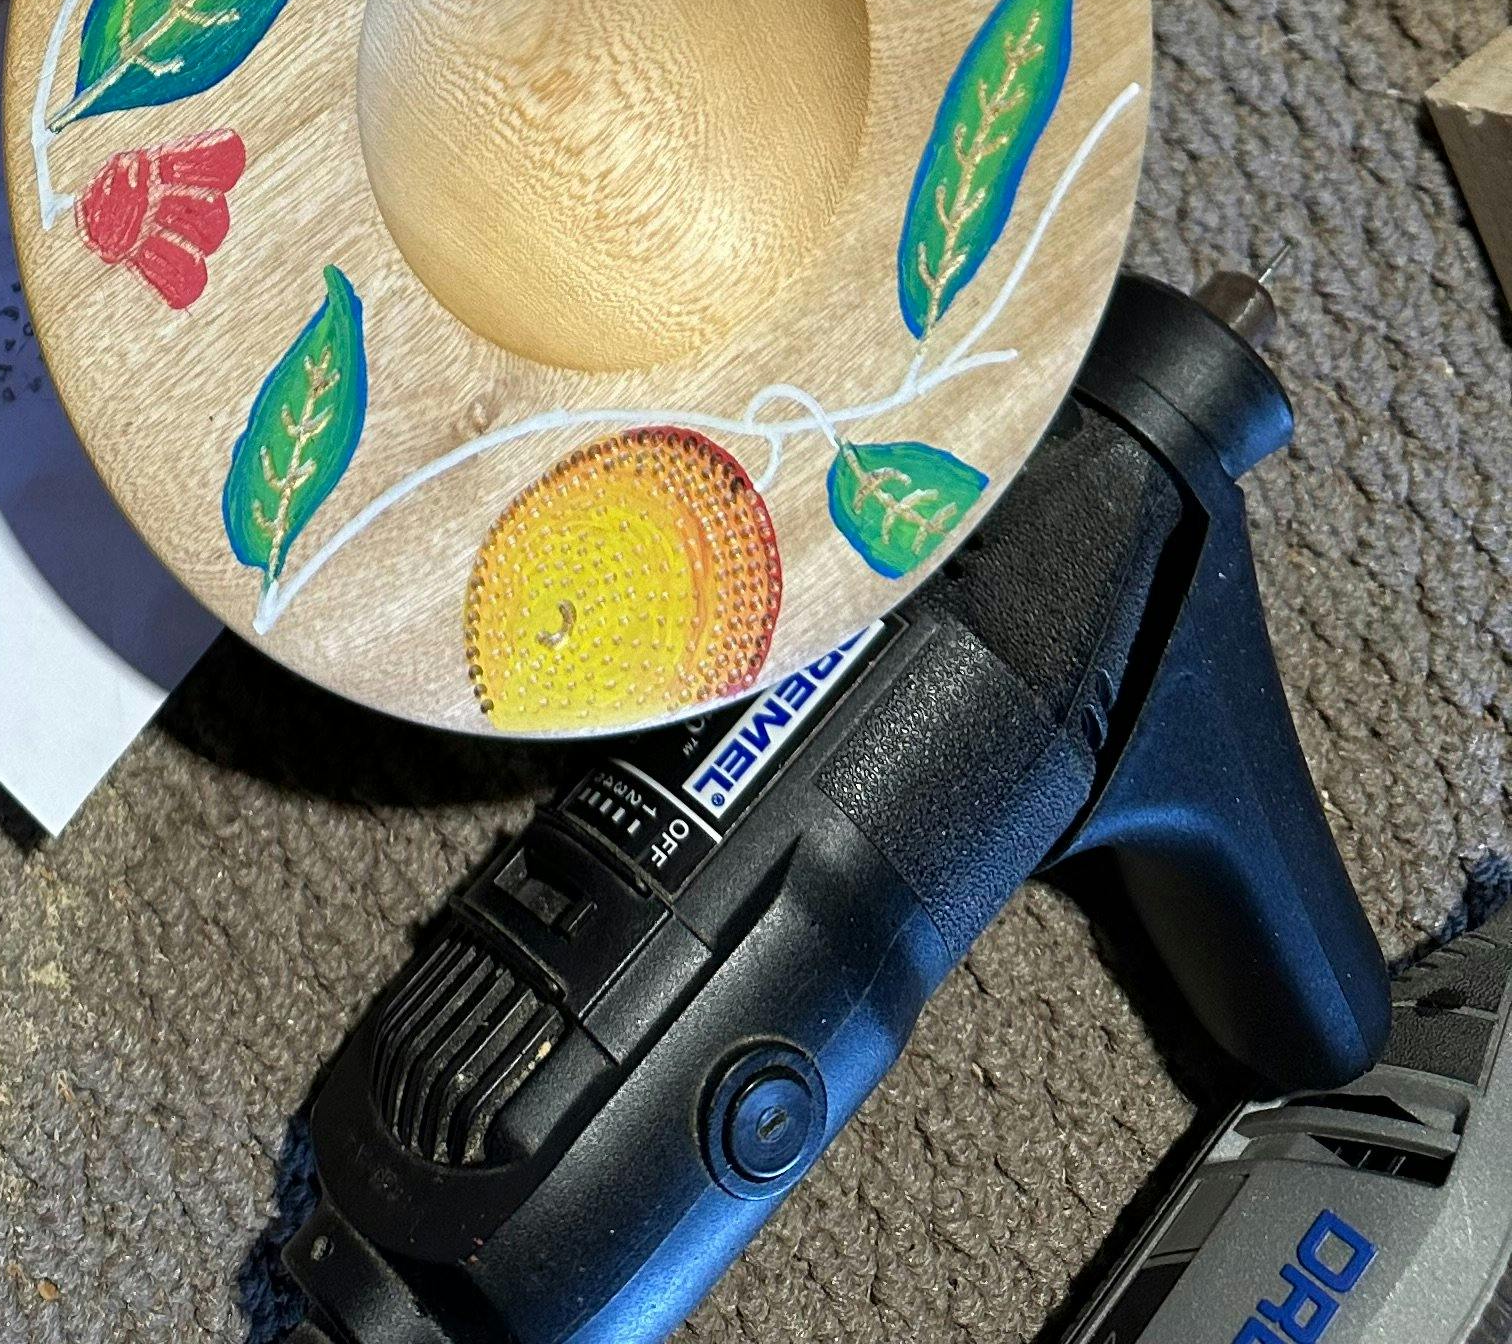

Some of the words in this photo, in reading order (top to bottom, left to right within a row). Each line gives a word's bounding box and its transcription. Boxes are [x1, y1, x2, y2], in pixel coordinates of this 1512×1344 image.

[613, 781, 628, 795] 3
[625, 789, 642, 806] 2
[642, 803, 657, 818] 1
[651, 817, 690, 868] OFF
